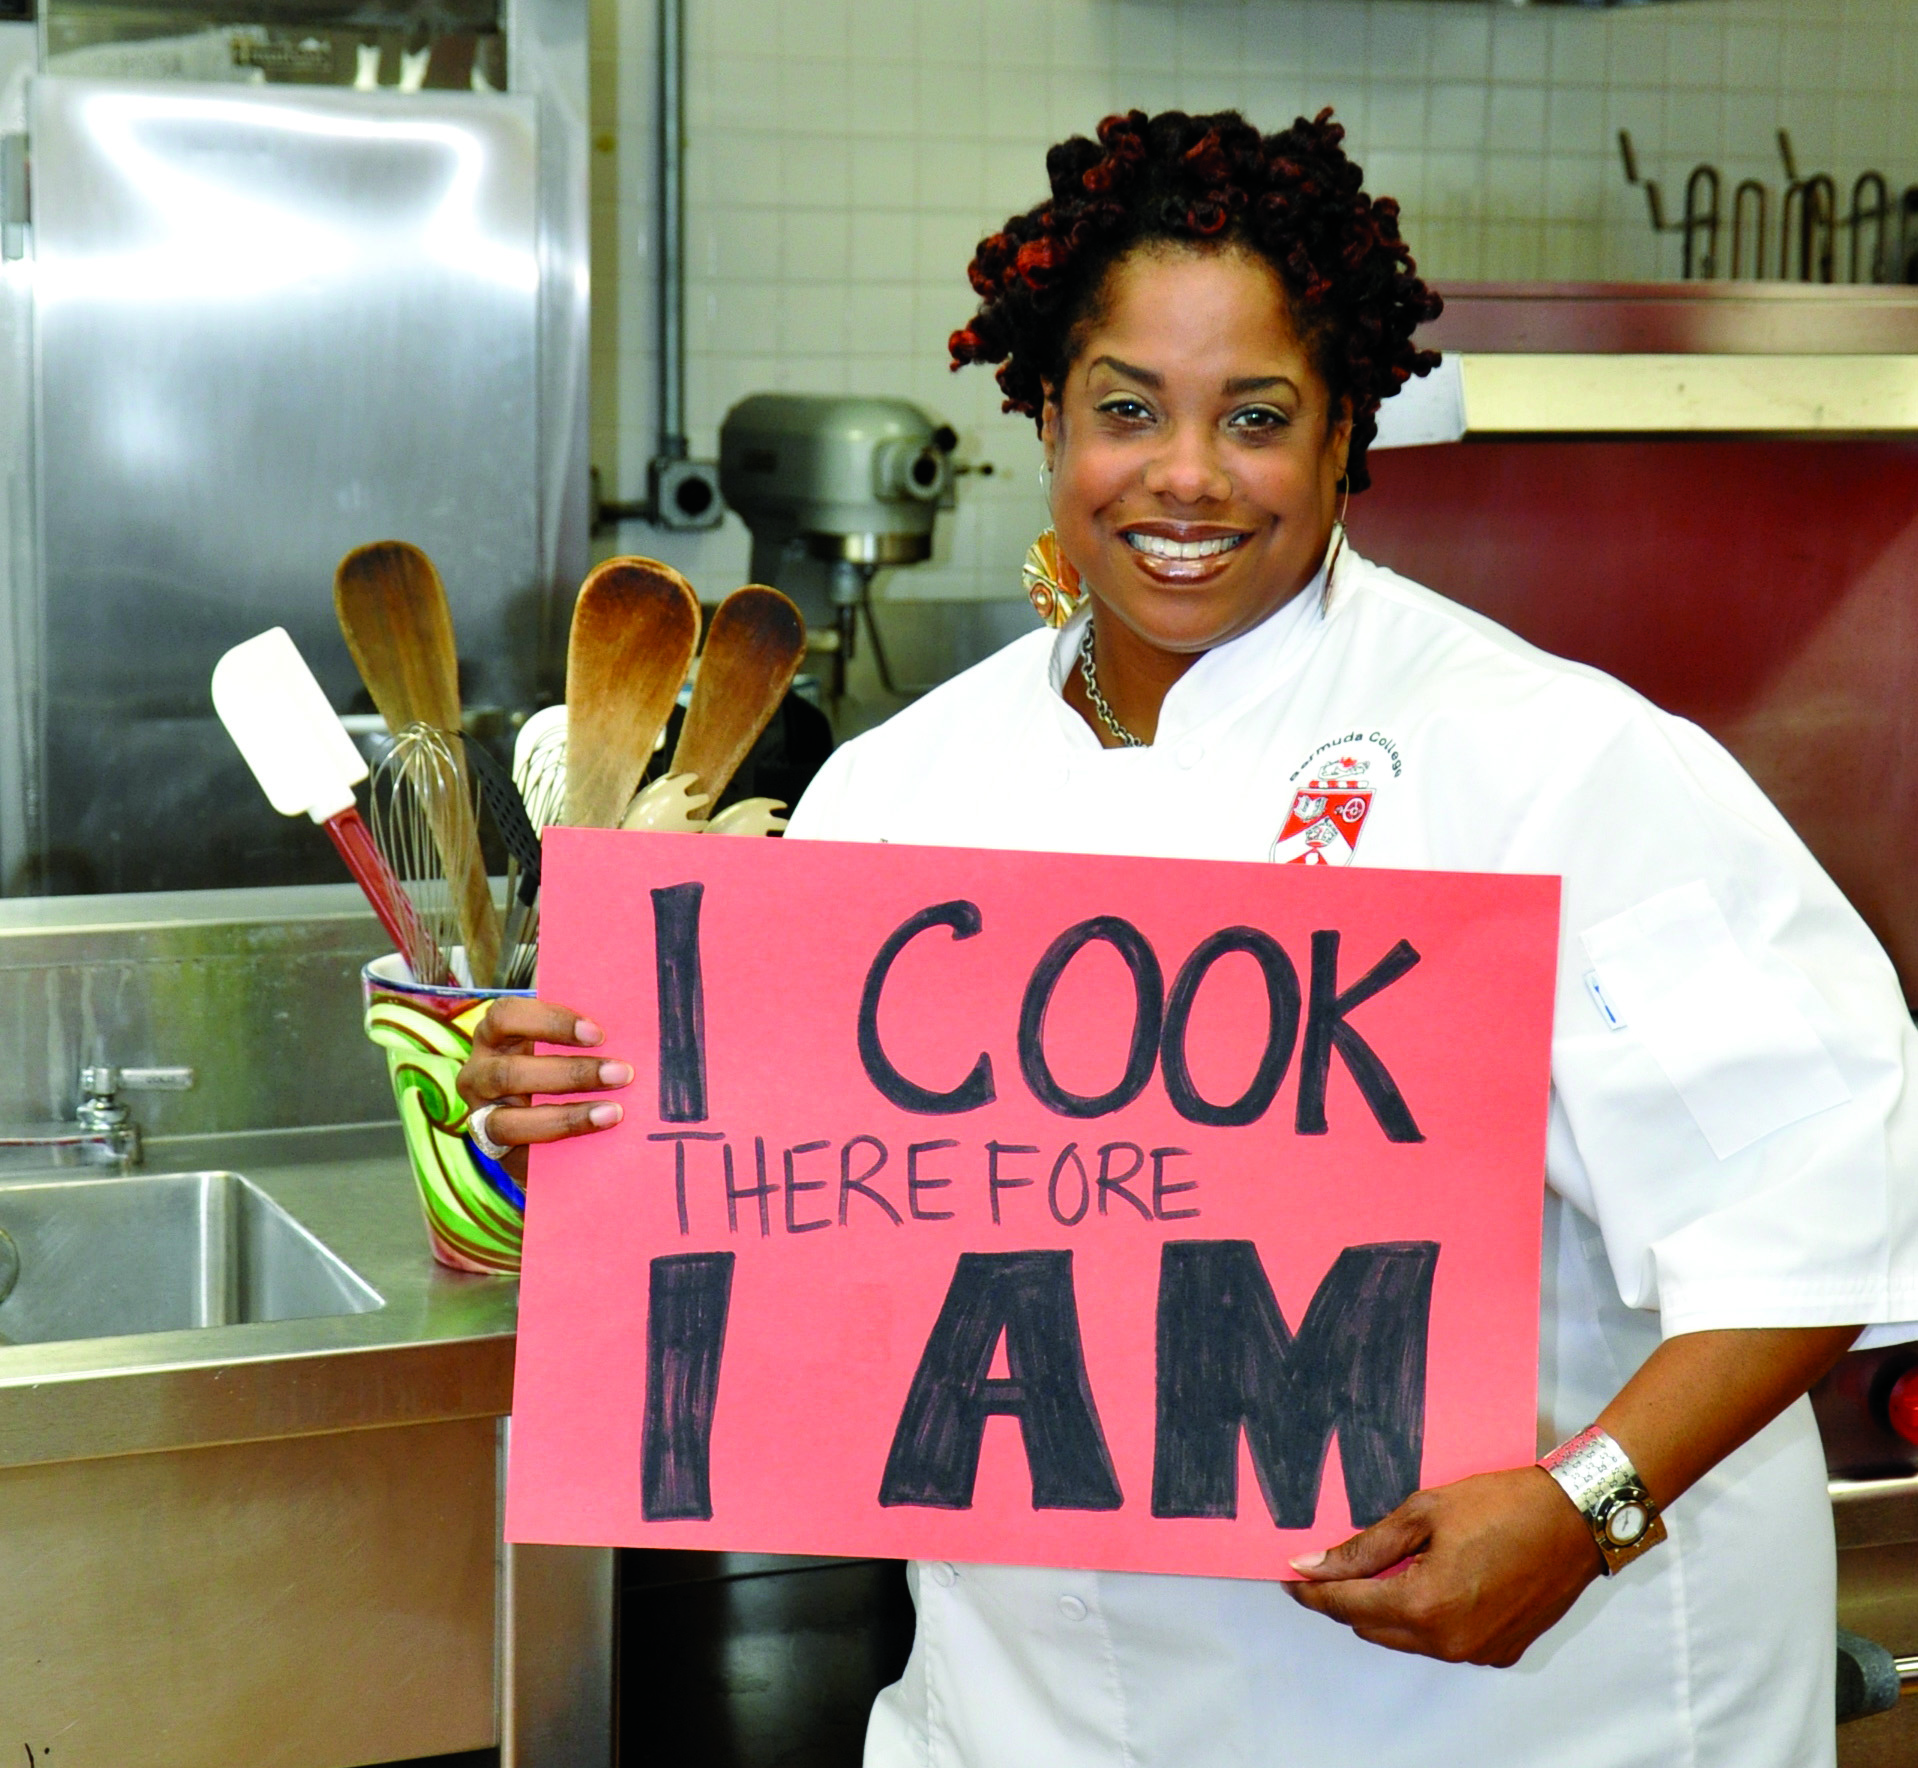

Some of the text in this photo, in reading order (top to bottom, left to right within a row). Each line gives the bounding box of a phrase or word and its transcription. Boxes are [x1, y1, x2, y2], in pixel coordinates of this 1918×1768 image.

[1368, 731, 1402, 778] College
[651, 881, 1427, 1144] I COOK
[646, 1131, 1202, 1238] THEREFORE
[640, 1238, 1442, 1530] I AM
